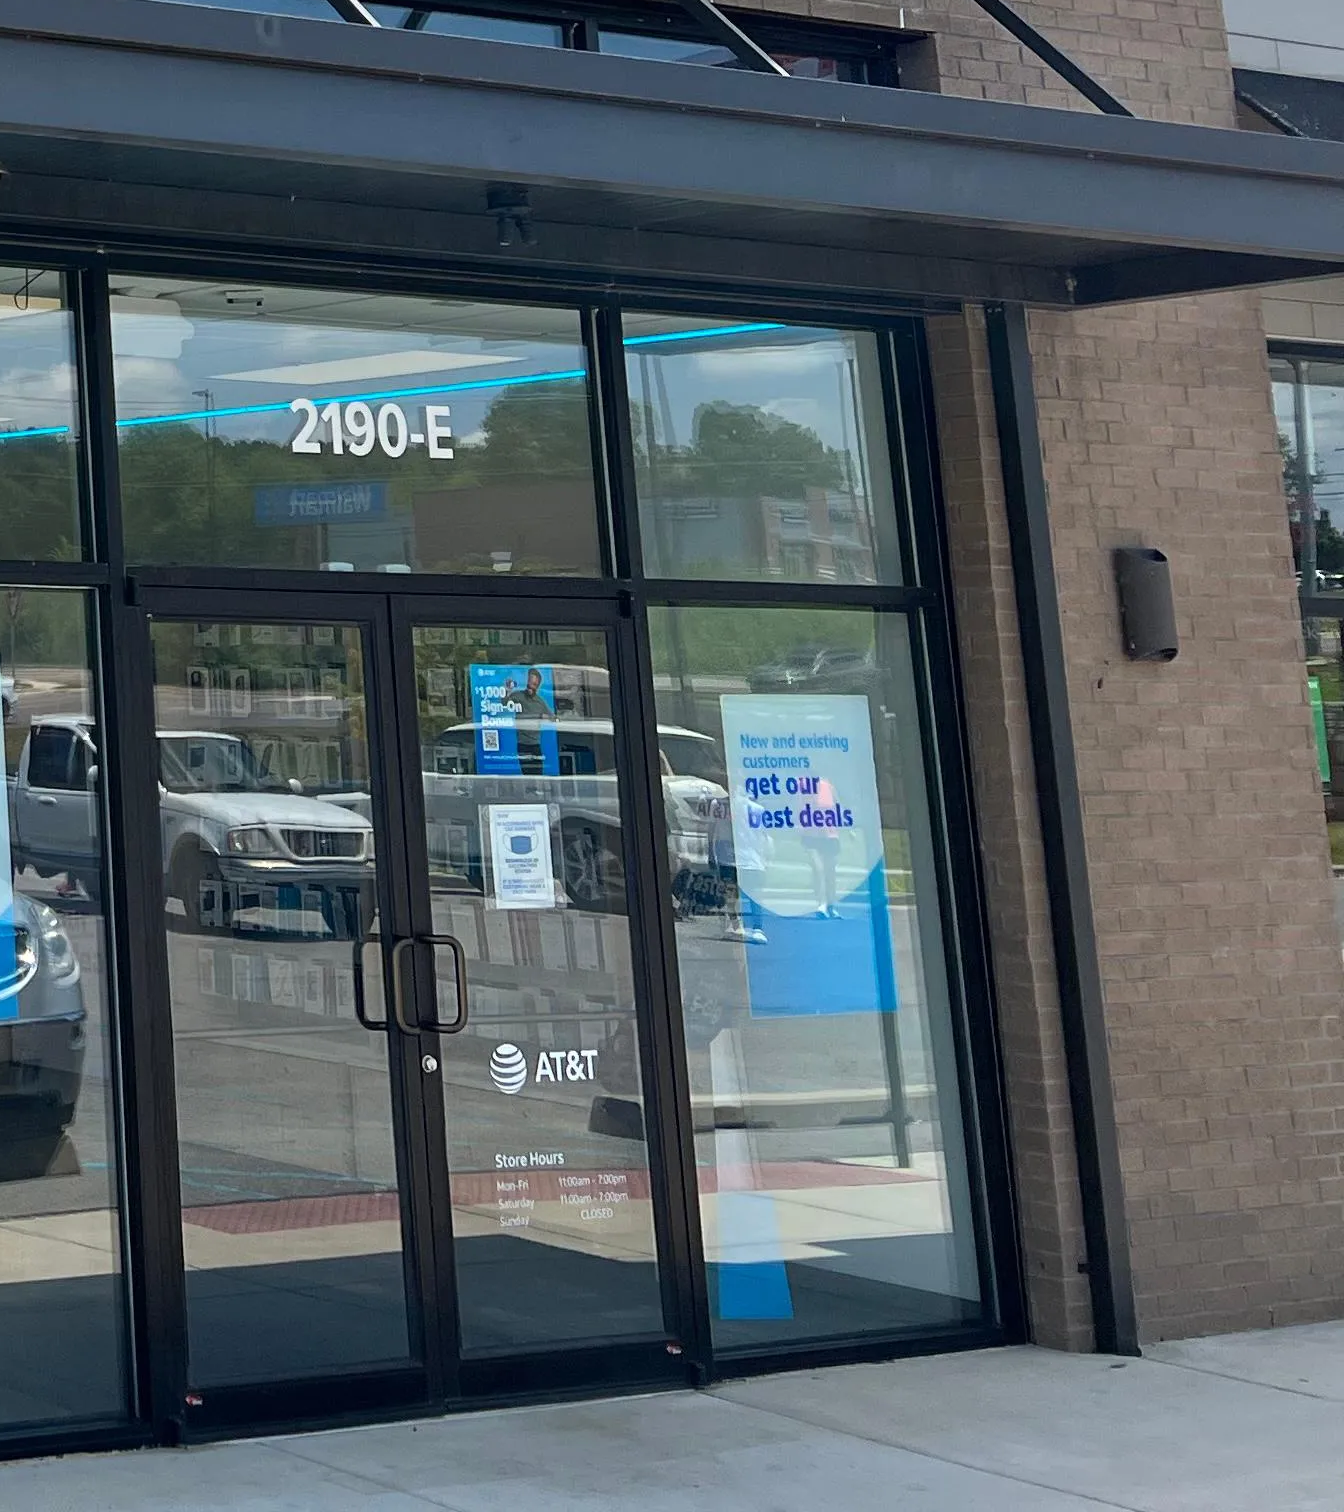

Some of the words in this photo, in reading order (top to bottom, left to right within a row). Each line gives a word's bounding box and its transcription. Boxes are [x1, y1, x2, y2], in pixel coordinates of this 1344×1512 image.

[290, 398, 454, 459] 2190-E
[475, 686, 506, 699] $1,000
[481, 700, 522, 715] Sign-On
[740, 734, 768, 748] New
[772, 733, 796, 748] and
[799, 733, 849, 753] existing
[743, 754, 810, 768] customers
[745, 773, 781, 799] get
[786, 776, 820, 795] our
[748, 806, 794, 828] best
[799, 803, 854, 828] deals
[535, 1049, 598, 1083] AT&T
[495, 1153, 528, 1168] Store
[529, 1151, 565, 1166] Hours
[496, 1179, 529, 1192] Mon-Fri
[498, 1197, 535, 1210] Saturday
[499, 1213, 530, 1227] Sunday
